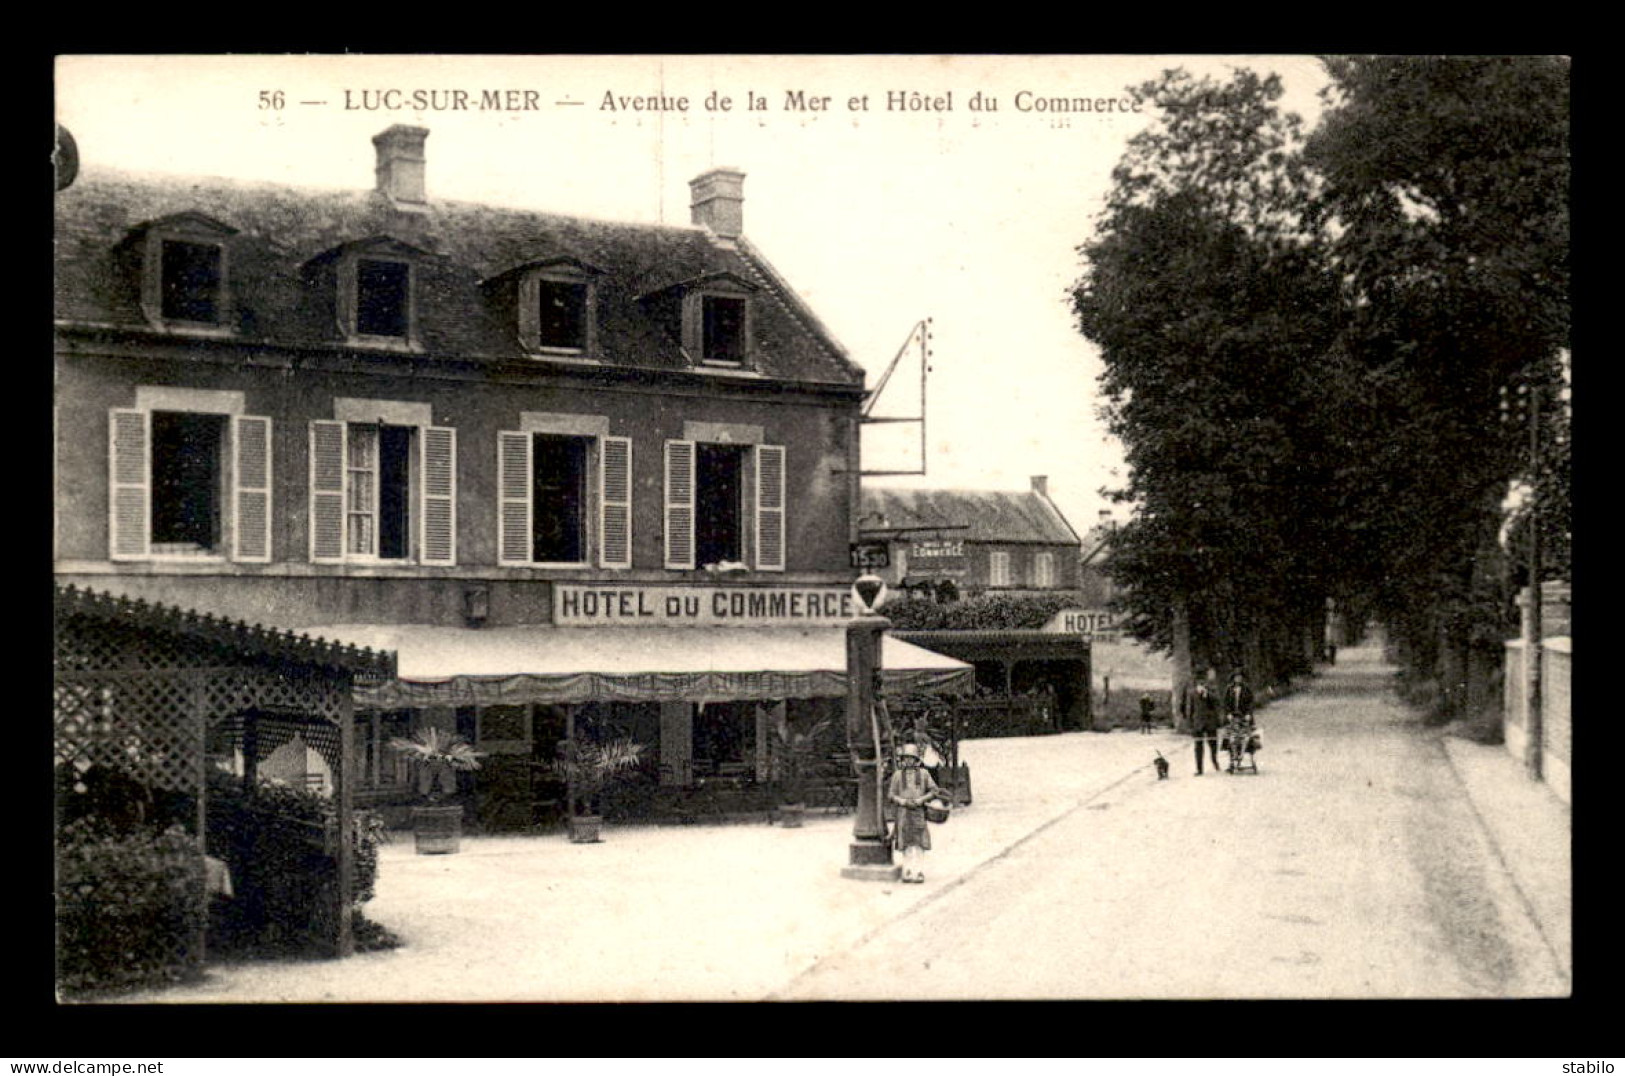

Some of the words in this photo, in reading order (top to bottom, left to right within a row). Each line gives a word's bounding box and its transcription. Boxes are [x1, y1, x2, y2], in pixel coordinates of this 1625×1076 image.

[562, 590, 653, 618] HOTEL
[665, 596, 699, 618] DU
[711, 591, 853, 619] COMMERCE
